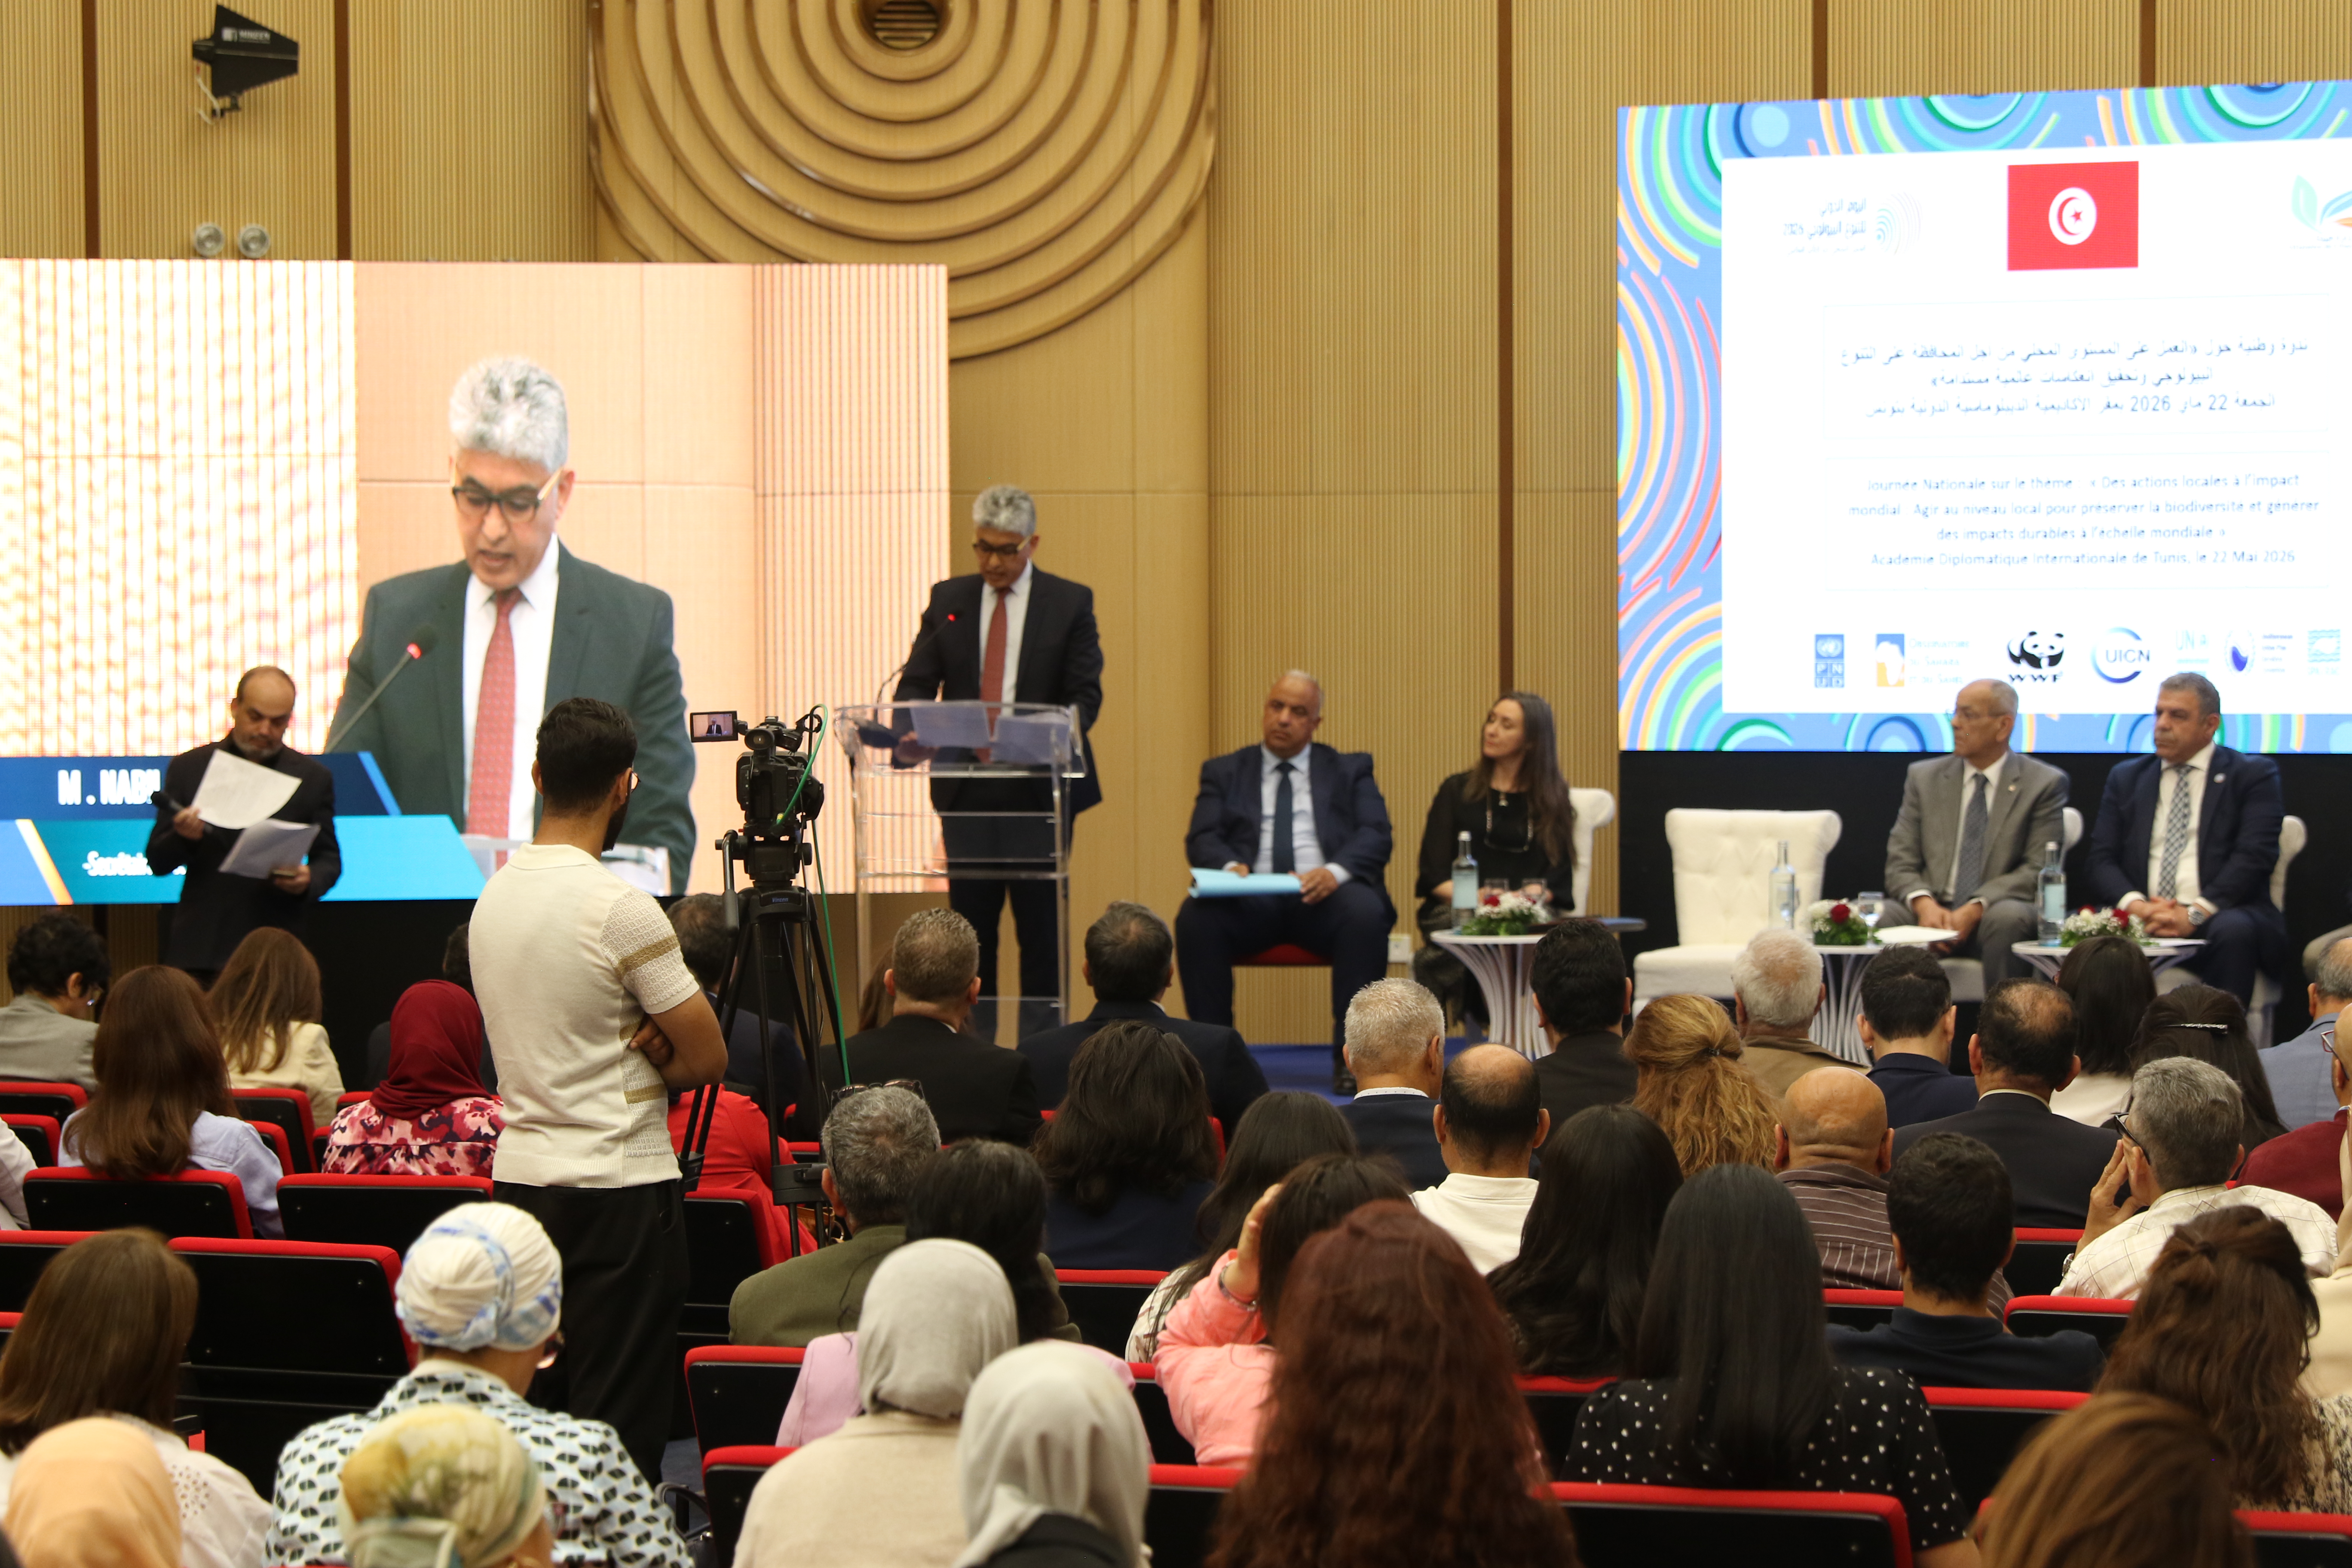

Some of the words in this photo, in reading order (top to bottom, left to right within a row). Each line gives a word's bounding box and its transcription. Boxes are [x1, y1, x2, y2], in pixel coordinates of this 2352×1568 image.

[1998, 346, 2015, 361] من
[2126, 341, 2149, 361] على
[2205, 340, 2232, 357] حول
[2238, 336, 2275, 356] وطنية
[2281, 338, 2308, 355] ندوة
[1882, 346, 1905, 366] على
[1910, 397, 1949, 417] الدولية
[2130, 395, 2171, 412] 2026
[2179, 397, 2202, 414] ماي
[2208, 394, 2228, 411] 22
[2234, 391, 2275, 410] الجمعة
[1923, 478, 1986, 490] Nationale
[1991, 481, 2011, 490] sur
[2015, 477, 2026, 489] le
[2102, 476, 2125, 489] Des
[2131, 477, 2178, 488] actions
[2183, 475, 2228, 487] locales
[1849, 504, 1901, 516] mondial
[1914, 504, 1939, 519] Agir
[1944, 506, 1959, 515] au
[1963, 505, 2006, 515] niveau
[2012, 502, 2041, 514] local
[2046, 505, 2077, 516] pour
[2082, 502, 2145, 516] préserver
[2150, 501, 2160, 513] la
[2165, 499, 2244, 513] biodiversité
[2249, 501, 2262, 512] et
[2267, 499, 2319, 515] générer
[1937, 528, 1959, 540] des
[1963, 529, 2014, 542] impacts
[2019, 527, 2075, 539] durables
[2151, 525, 2213, 539] mondiale
[1871, 554, 1934, 565] Académie
[1940, 553, 2028, 567] Diplomatique
[2034, 552, 2127, 564] Internationale
[2132, 551, 2147, 564] de
[2196, 551, 2207, 563] le
[2213, 551, 2227, 563] 22
[2233, 551, 2258, 563] Mai
[2263, 550, 2295, 563] 2026
[2105, 649, 2150, 664] UICN
[2008, 673, 2063, 683] WWF
